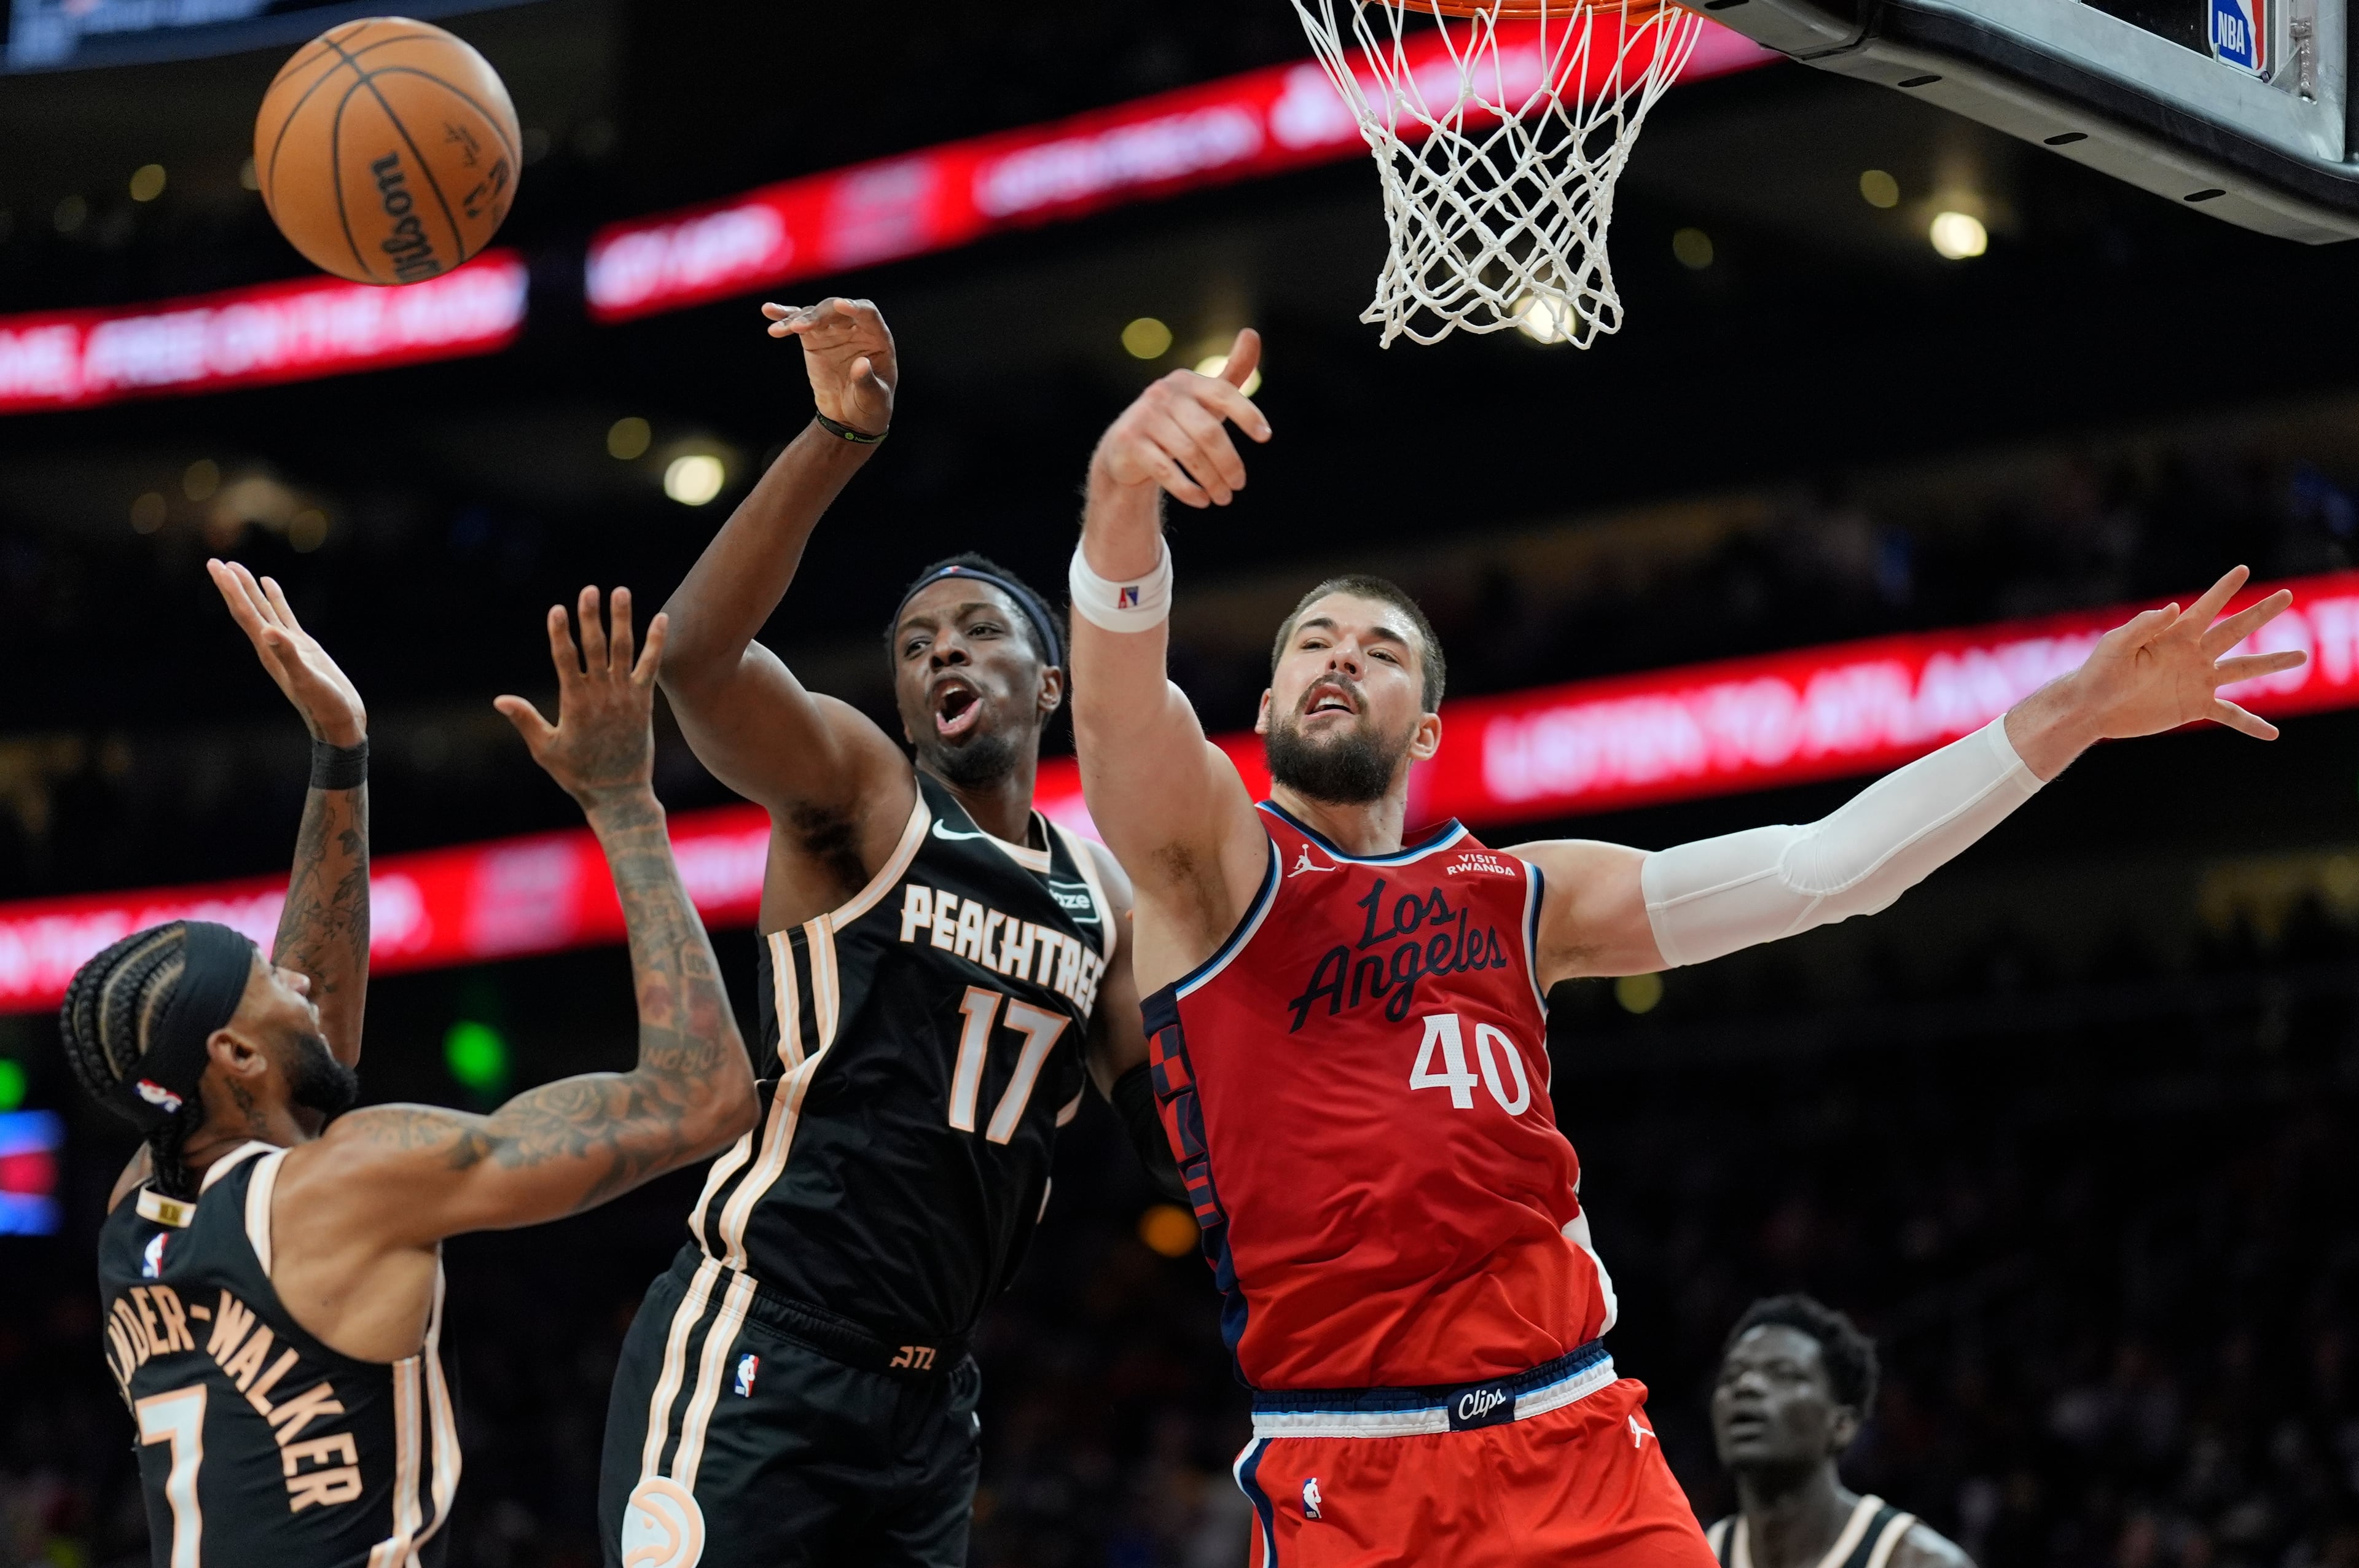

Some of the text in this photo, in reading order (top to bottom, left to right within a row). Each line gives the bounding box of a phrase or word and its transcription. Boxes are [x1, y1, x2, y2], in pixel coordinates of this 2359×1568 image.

[2217, 10, 2246, 55] NBA
[1447, 862, 1516, 877] RWANDA
[1458, 853, 1498, 865] VISIT
[901, 884, 1105, 1019] PEACHTREE
[1356, 878, 1457, 951] Los
[1288, 908, 1507, 1034] Angeles
[949, 985, 1072, 1145] 17
[1409, 1013, 1531, 1116] 40
[1458, 1387, 1506, 1421] Clips
[135, 1384, 206, 1568] 7
